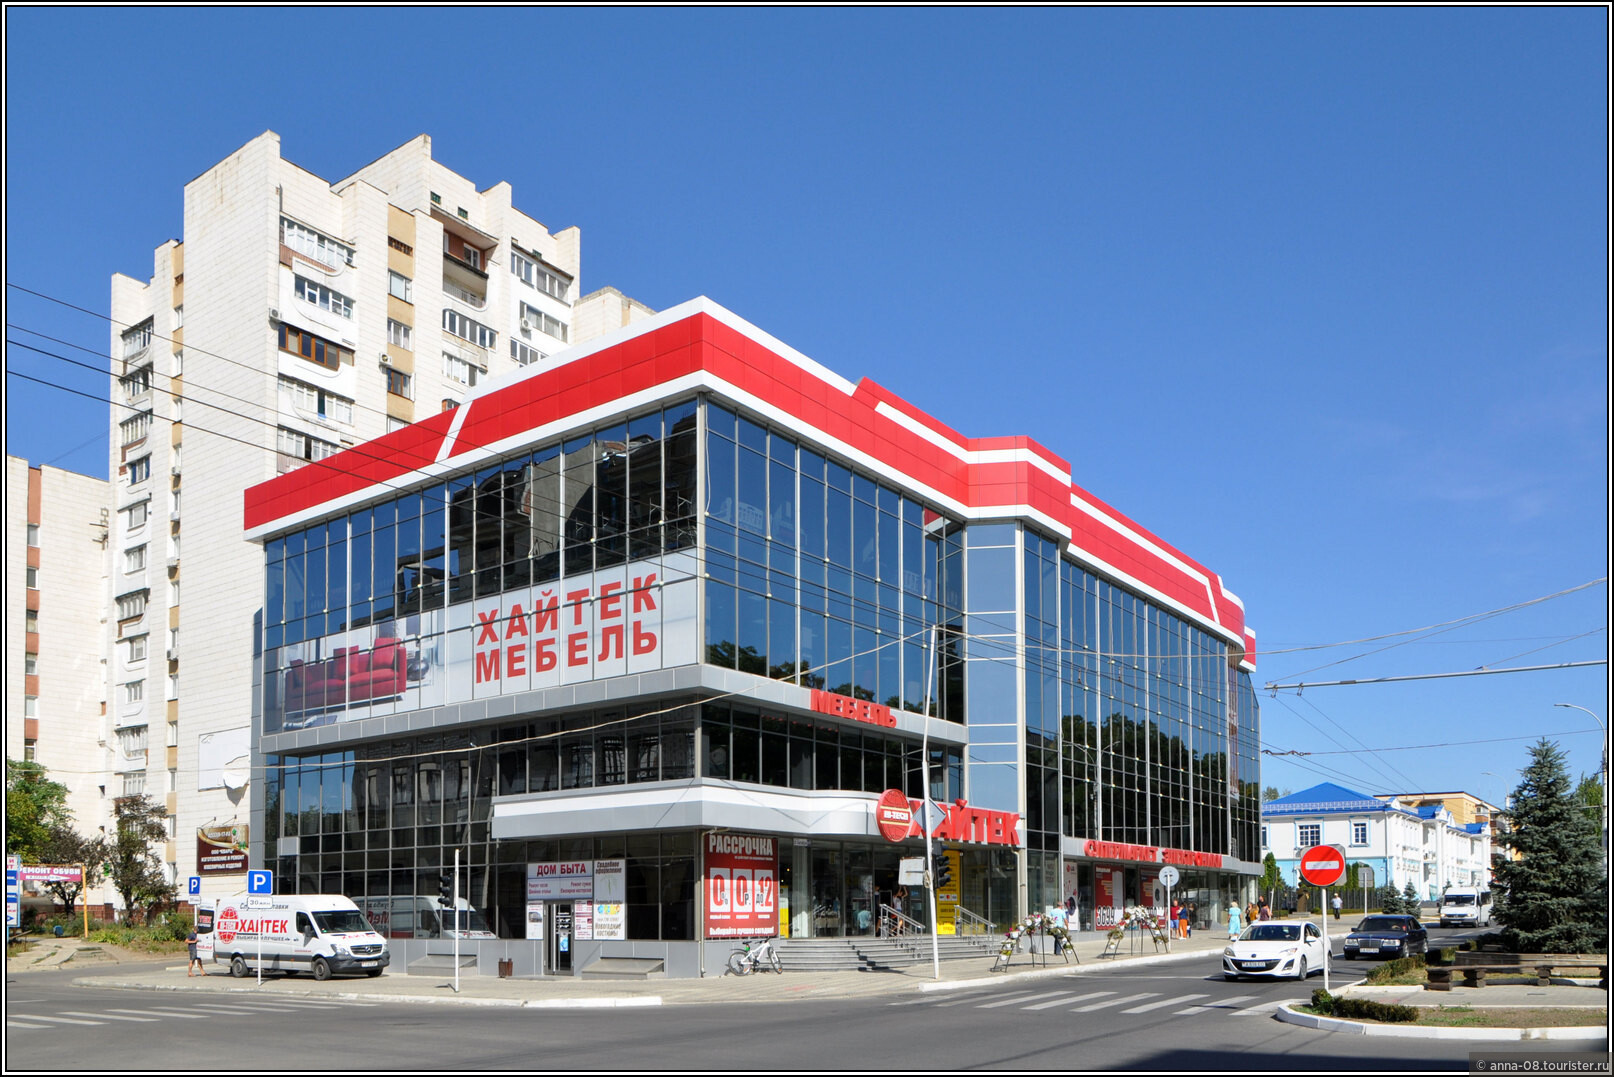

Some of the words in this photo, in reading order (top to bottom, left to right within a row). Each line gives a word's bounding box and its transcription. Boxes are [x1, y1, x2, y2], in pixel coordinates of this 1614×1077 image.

[476, 572, 658, 646] ХАЙТЕК
[475, 620, 658, 684] МЕБЕЛЬ
[810, 688, 897, 728] МЕБЕЛЬ
[708, 834, 774, 856] РАССРОЧКА
[1083, 839, 1159, 863] СУПЕРМАРКЕТ
[536, 864, 557, 877] ДОМ
[560, 863, 586, 875] БЫТА
[191, 879, 198, 892] P
[253, 874, 266, 891] P
[239, 916, 288, 934] ХАЙТЕК
